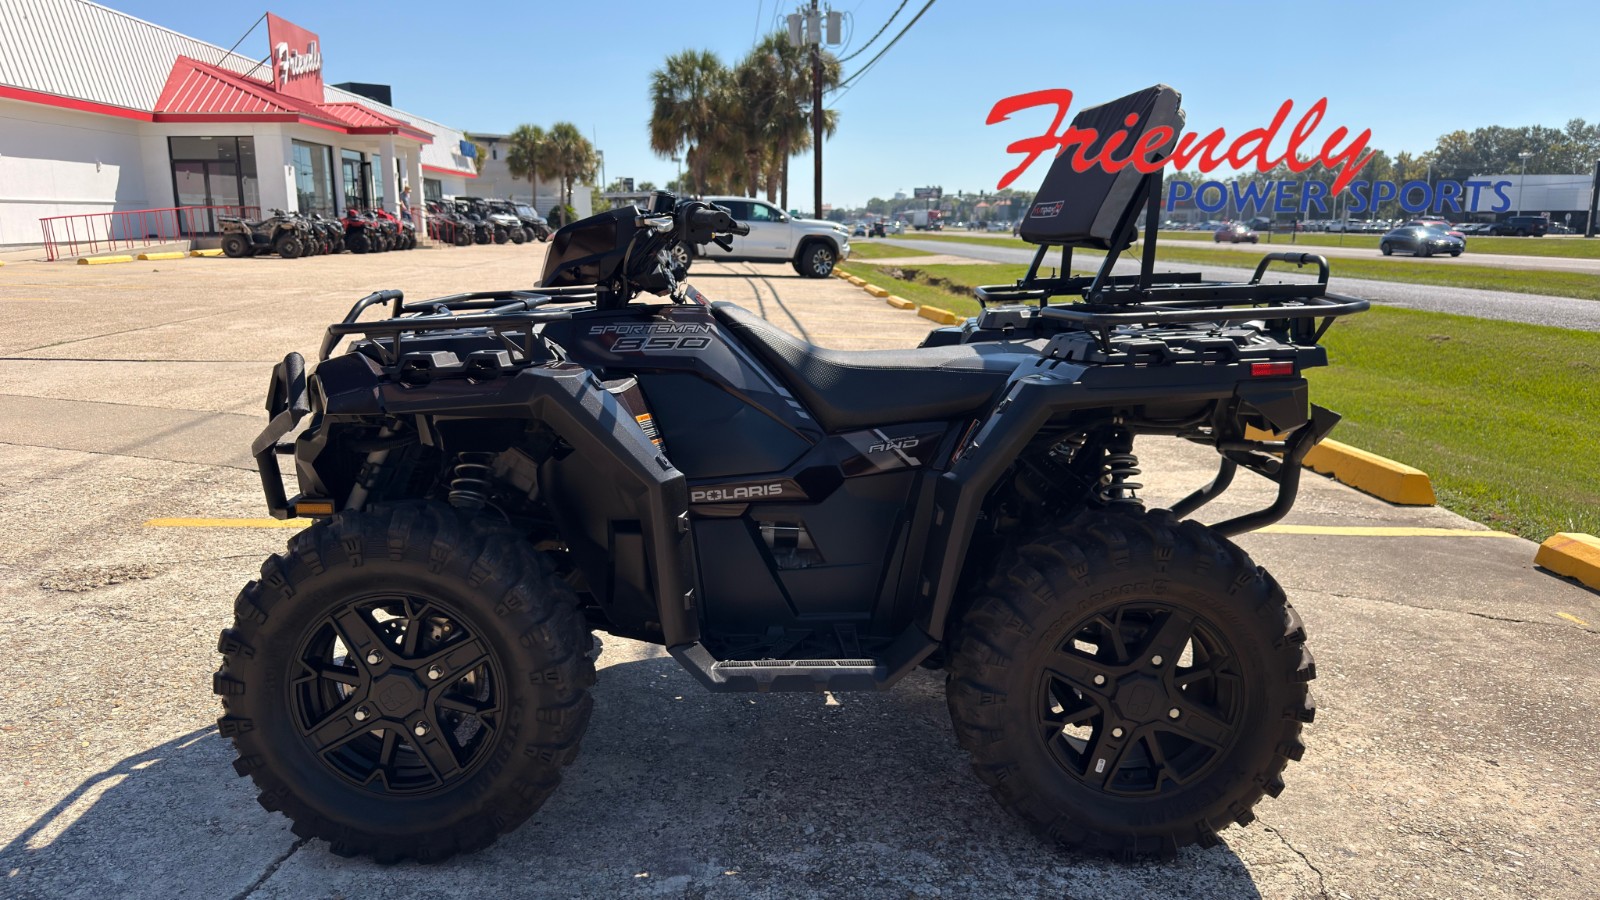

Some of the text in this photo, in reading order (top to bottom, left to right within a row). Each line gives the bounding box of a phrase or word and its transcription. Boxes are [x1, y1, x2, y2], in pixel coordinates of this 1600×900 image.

[588, 323, 713, 335] SPORTSMAN
[609, 336, 713, 353] 850
[868, 439, 919, 454] AWD
[691, 483, 783, 503] POLARIS
